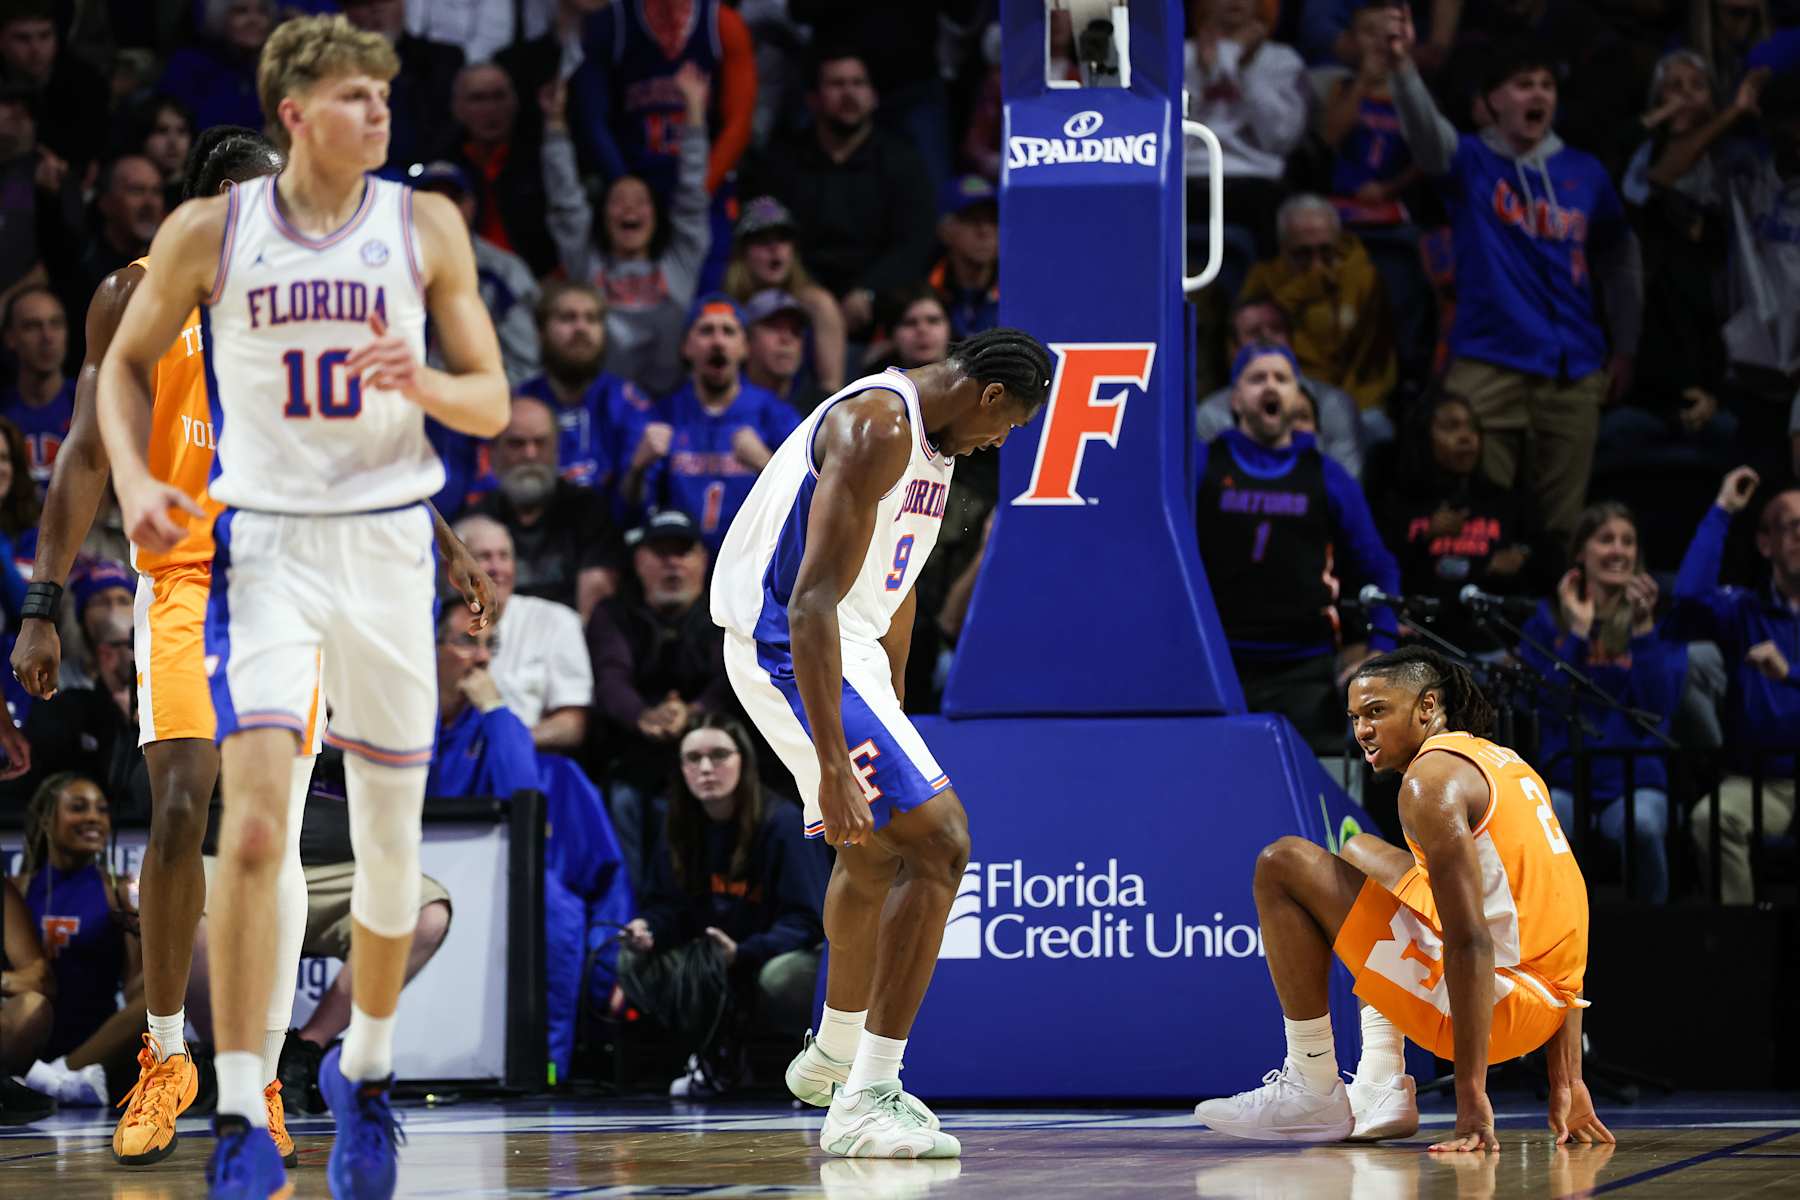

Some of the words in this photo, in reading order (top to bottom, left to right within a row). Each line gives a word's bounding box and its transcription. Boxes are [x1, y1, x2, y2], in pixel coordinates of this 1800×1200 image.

[1008, 132, 1158, 169] SPALDING
[247, 280, 389, 329] FLORIDA
[283, 348, 363, 419] 10
[1010, 342, 1157, 506] F
[885, 533, 915, 592] 9
[848, 739, 884, 805] F
[1519, 776, 1569, 854] 2
[986, 858, 1147, 908] Florida
[984, 909, 1134, 960] Credit
